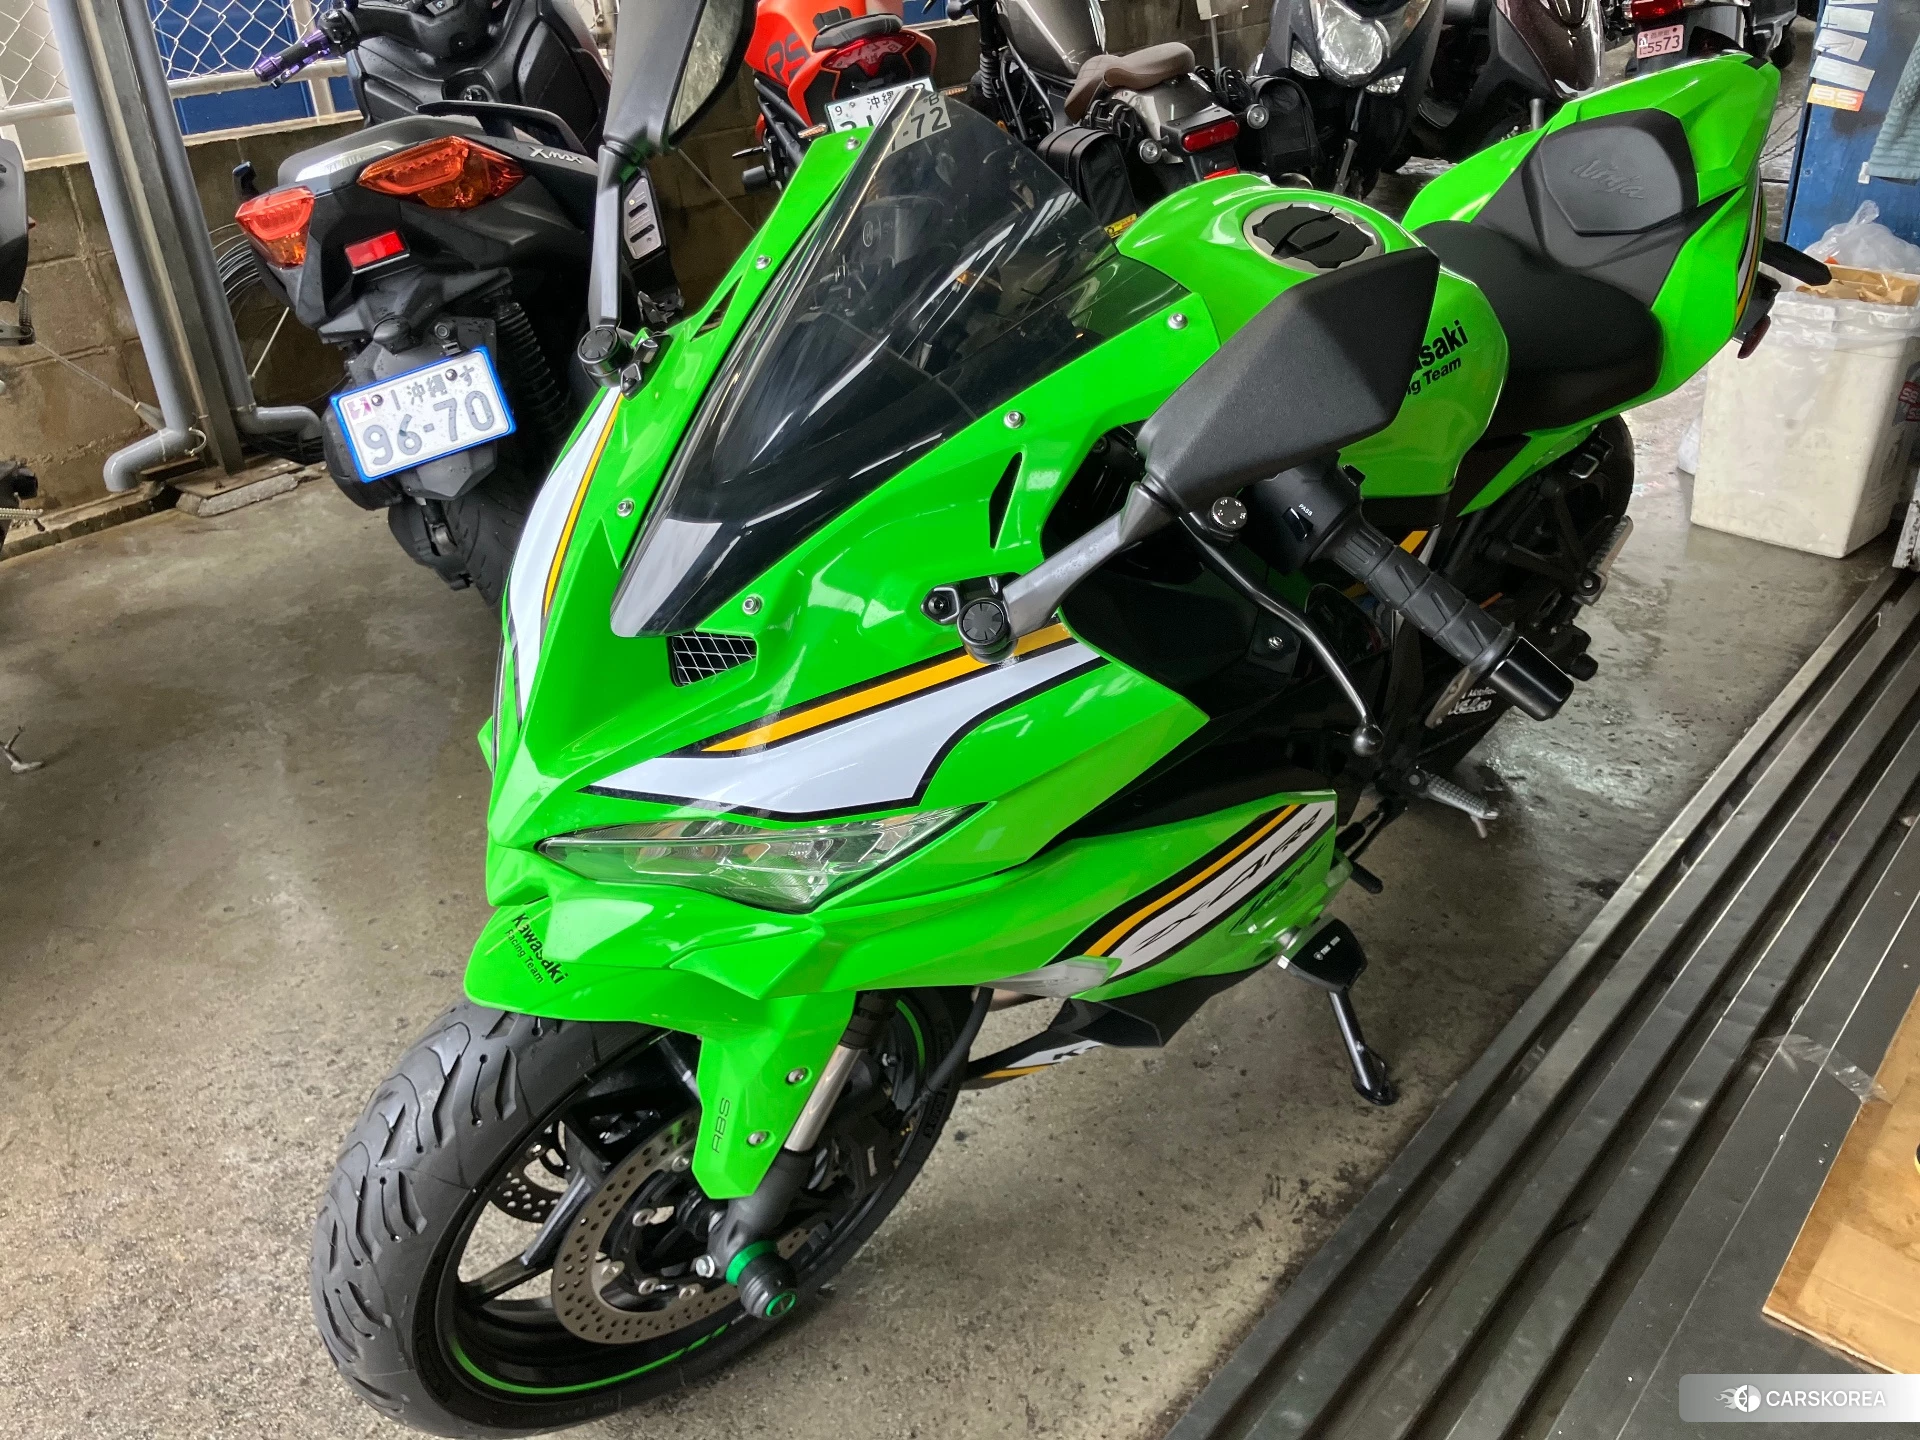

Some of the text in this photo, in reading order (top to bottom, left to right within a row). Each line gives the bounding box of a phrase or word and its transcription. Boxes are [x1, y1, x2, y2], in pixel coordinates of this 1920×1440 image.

[1647, 35, 1680, 54] 5573
[834, 105, 843, 116] 9
[1571, 159, 1644, 199] Ninja
[1417, 319, 1468, 368] saki
[407, 374, 447, 405] 沖縄
[459, 365, 475, 387] す
[1422, 357, 1461, 385] Team
[363, 390, 494, 466] 96-70
[1298, 503, 1313, 517] PASS
[506, 929, 545, 984] Racing Team
[512, 912, 569, 984] Kawasaki
[712, 1097, 730, 1153] ABS
